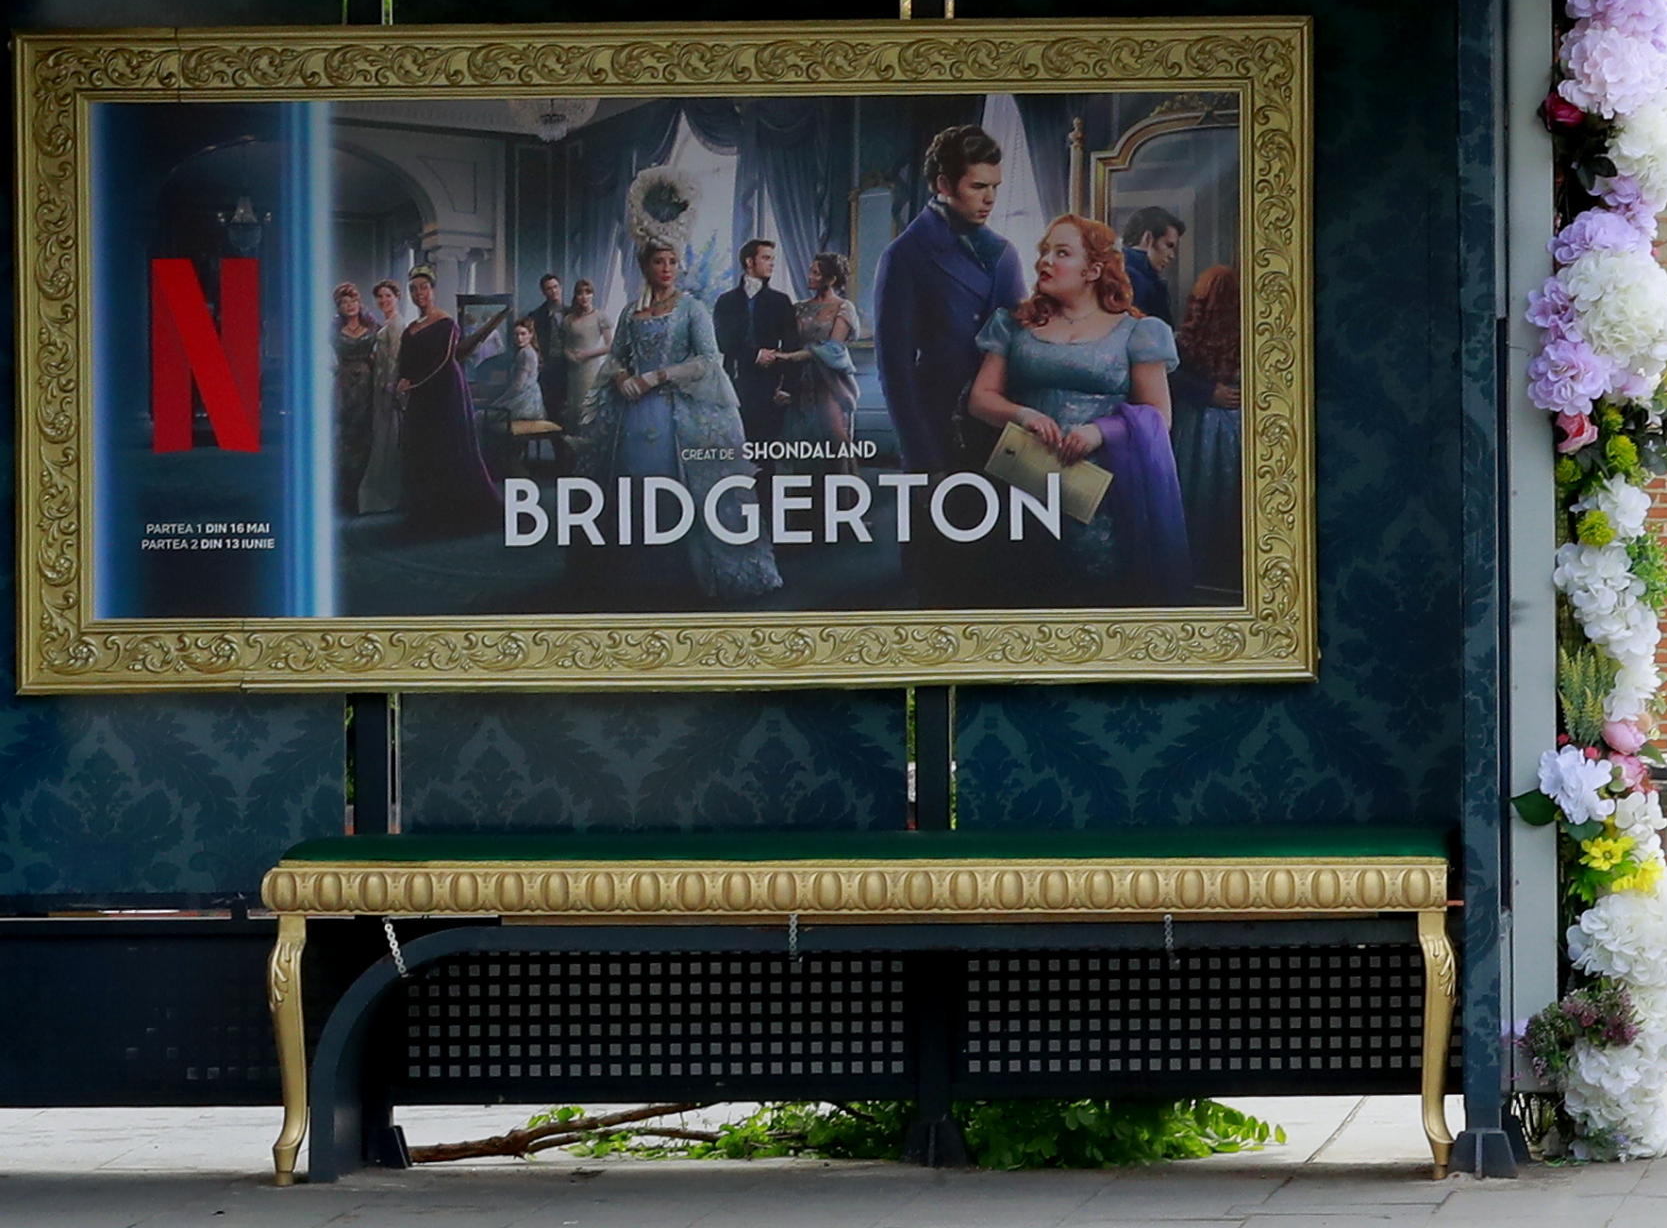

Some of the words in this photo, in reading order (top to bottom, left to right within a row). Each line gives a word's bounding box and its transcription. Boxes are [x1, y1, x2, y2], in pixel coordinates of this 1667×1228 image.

[151, 258, 261, 453] N
[681, 449, 717, 461] CREAT
[719, 448, 735, 460] DE
[742, 441, 877, 460] SHONDALAND
[503, 472, 1061, 547] BRIDGERTON
[146, 523, 194, 534] PARTEA
[196, 523, 202, 534] 1
[205, 523, 227, 533] DIN
[230, 523, 245, 533] 16
[246, 523, 270, 533] MAI
[141, 539, 189, 550] PARTEA
[190, 539, 199, 550] 2
[201, 539, 223, 549] DIN
[225, 539, 240, 549] 13
[241, 538, 275, 549] IUNIE
